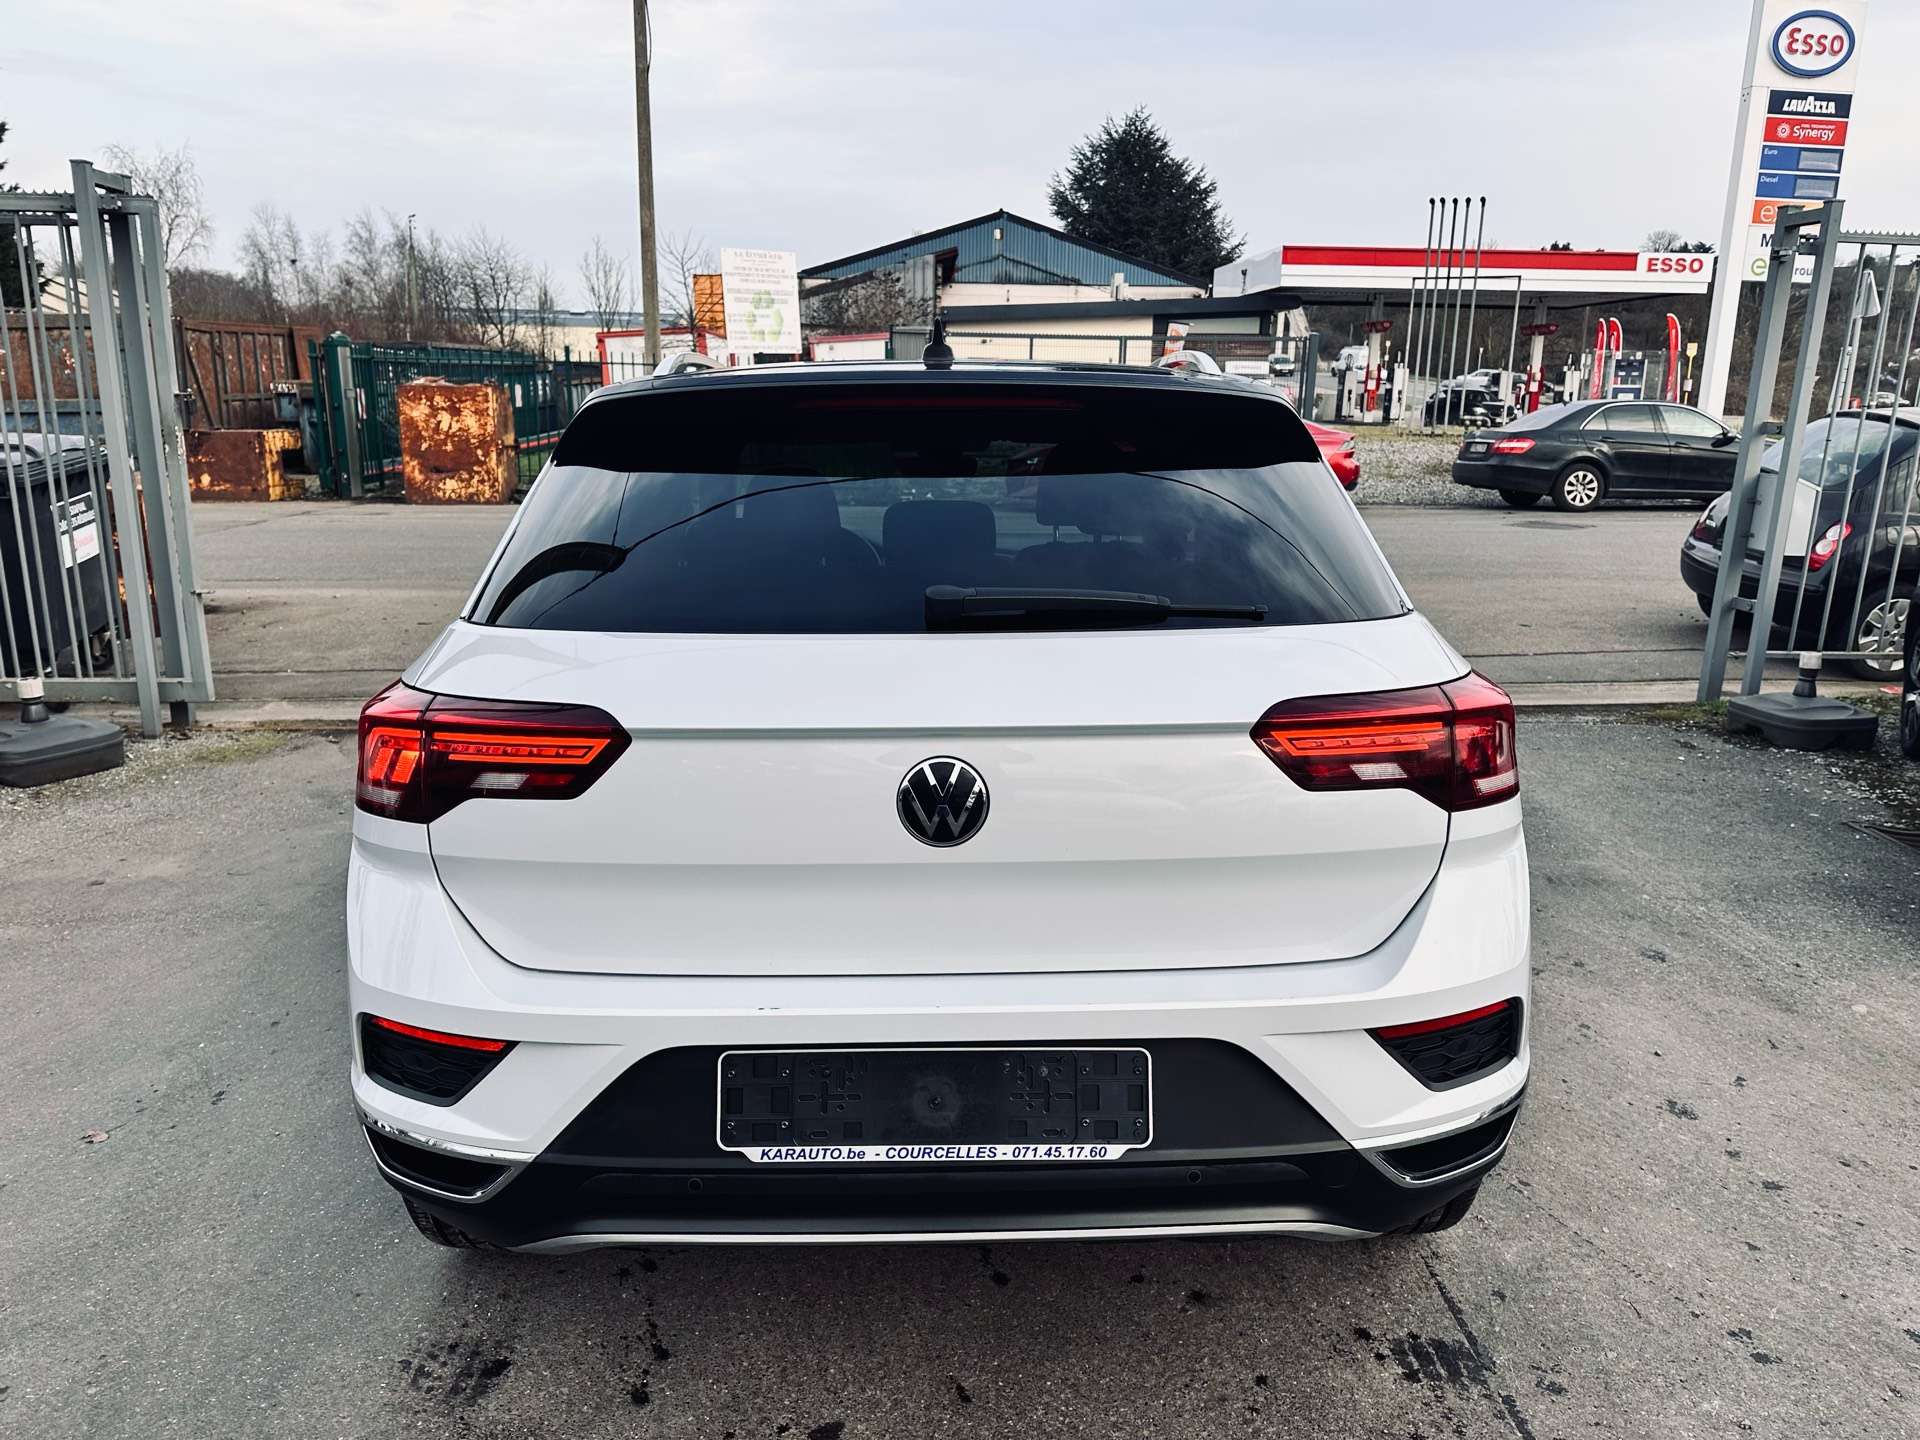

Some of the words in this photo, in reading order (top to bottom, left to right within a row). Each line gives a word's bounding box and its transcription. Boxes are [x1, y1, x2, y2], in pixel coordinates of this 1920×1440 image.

[1782, 95, 1836, 114] LAVAZZA
[1793, 125, 1835, 141] Synergy
[1760, 175, 1779, 183] Diesel
[1647, 257, 1704, 273] ESSO
[760, 1148, 866, 1160] KARAUTO.be
[885, 1147, 997, 1159] COURCELLES
[1012, 1146, 1107, 1158] 071.45.17.60
